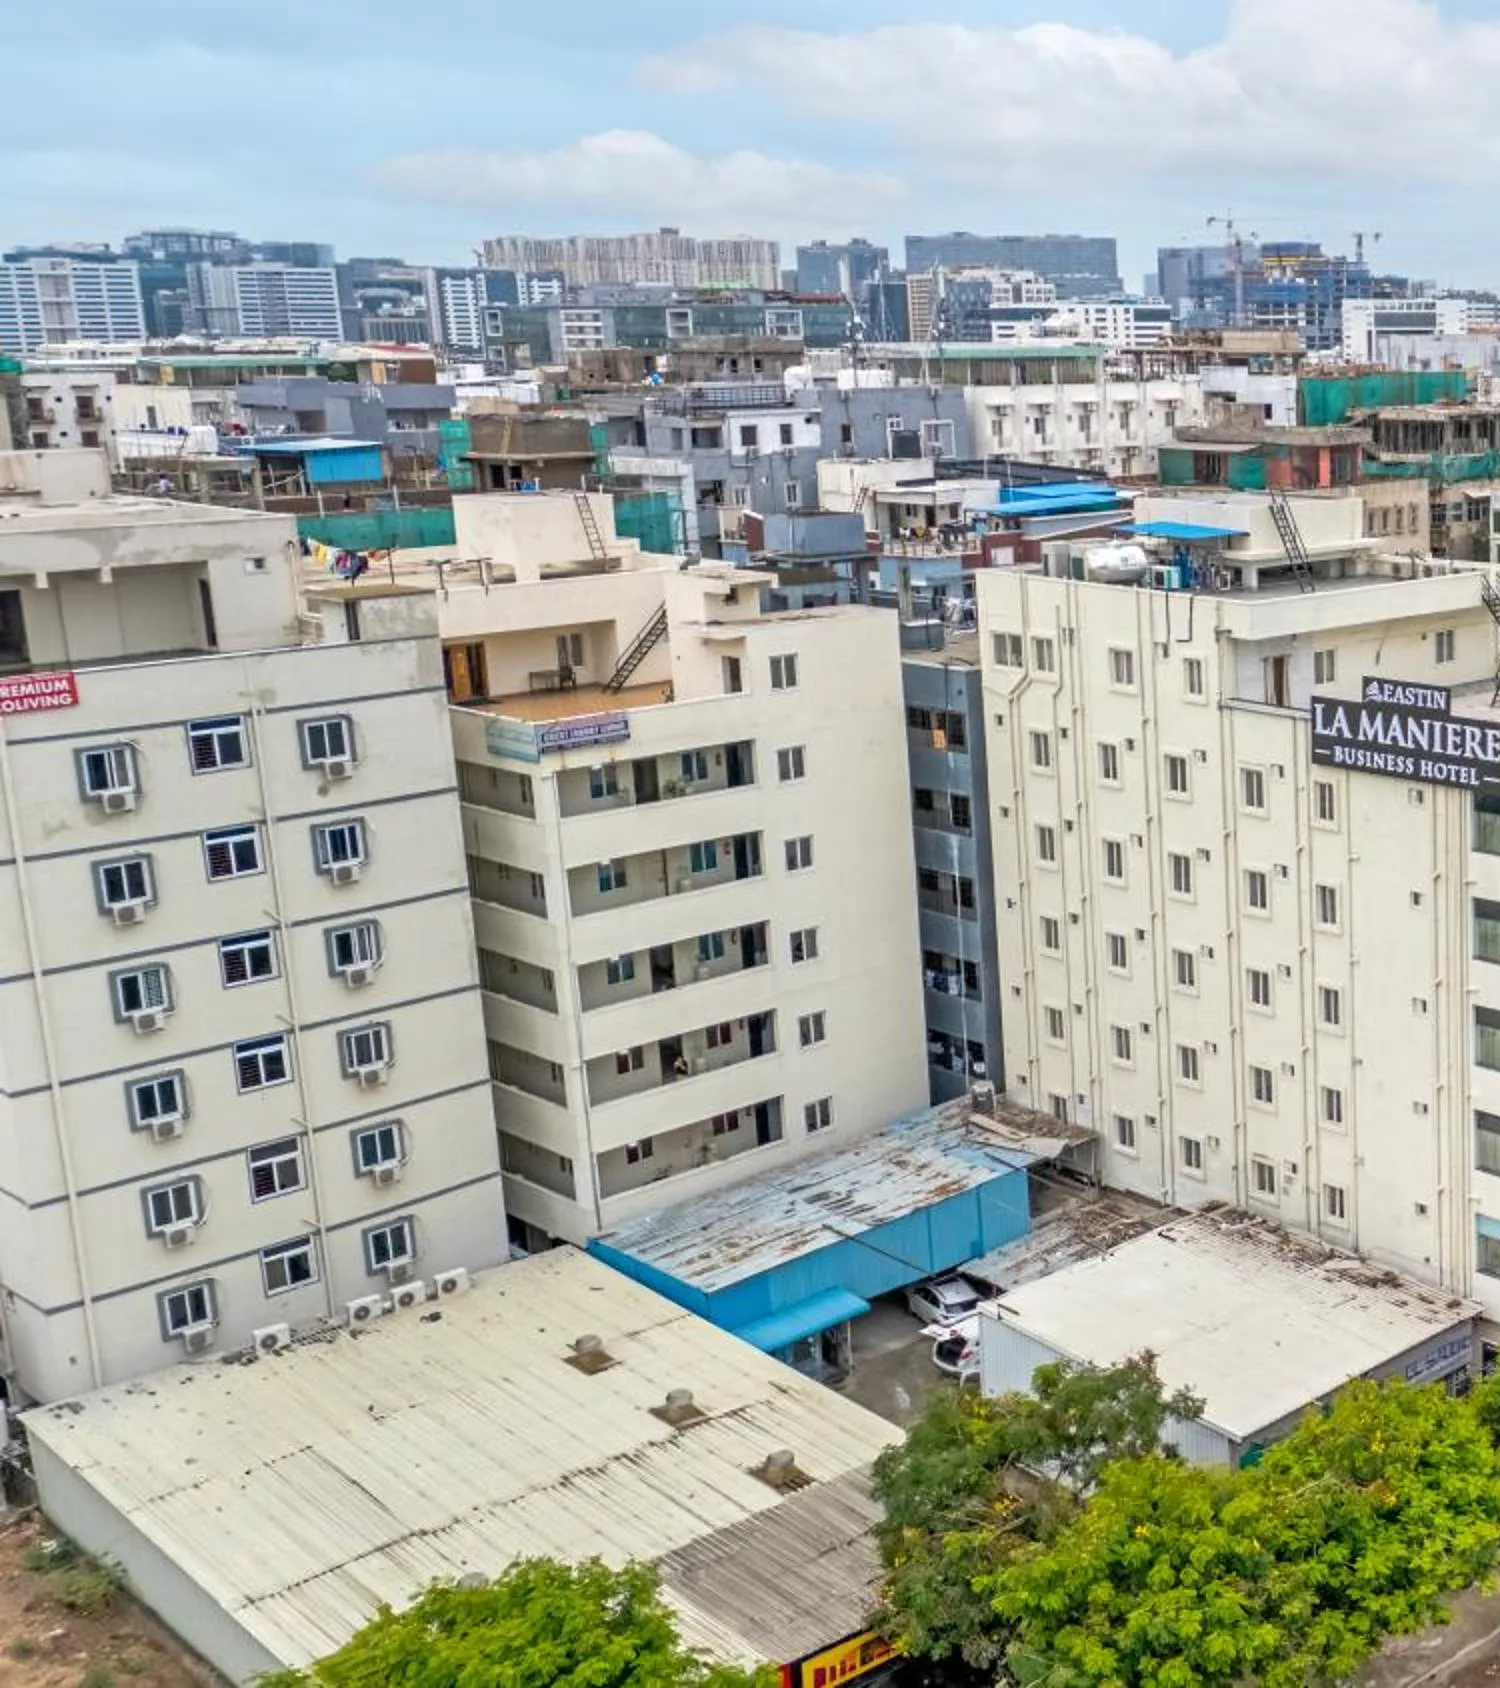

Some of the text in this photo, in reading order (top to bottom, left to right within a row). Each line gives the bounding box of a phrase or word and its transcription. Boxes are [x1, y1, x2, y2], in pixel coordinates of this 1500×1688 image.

[0, 679, 69, 698] REMIUM
[0, 692, 72, 712] OLIVING
[1382, 683, 1447, 710] EASTIN
[1314, 703, 1353, 739] LA
[1333, 745, 1480, 785] BUSINESS HOTEL
